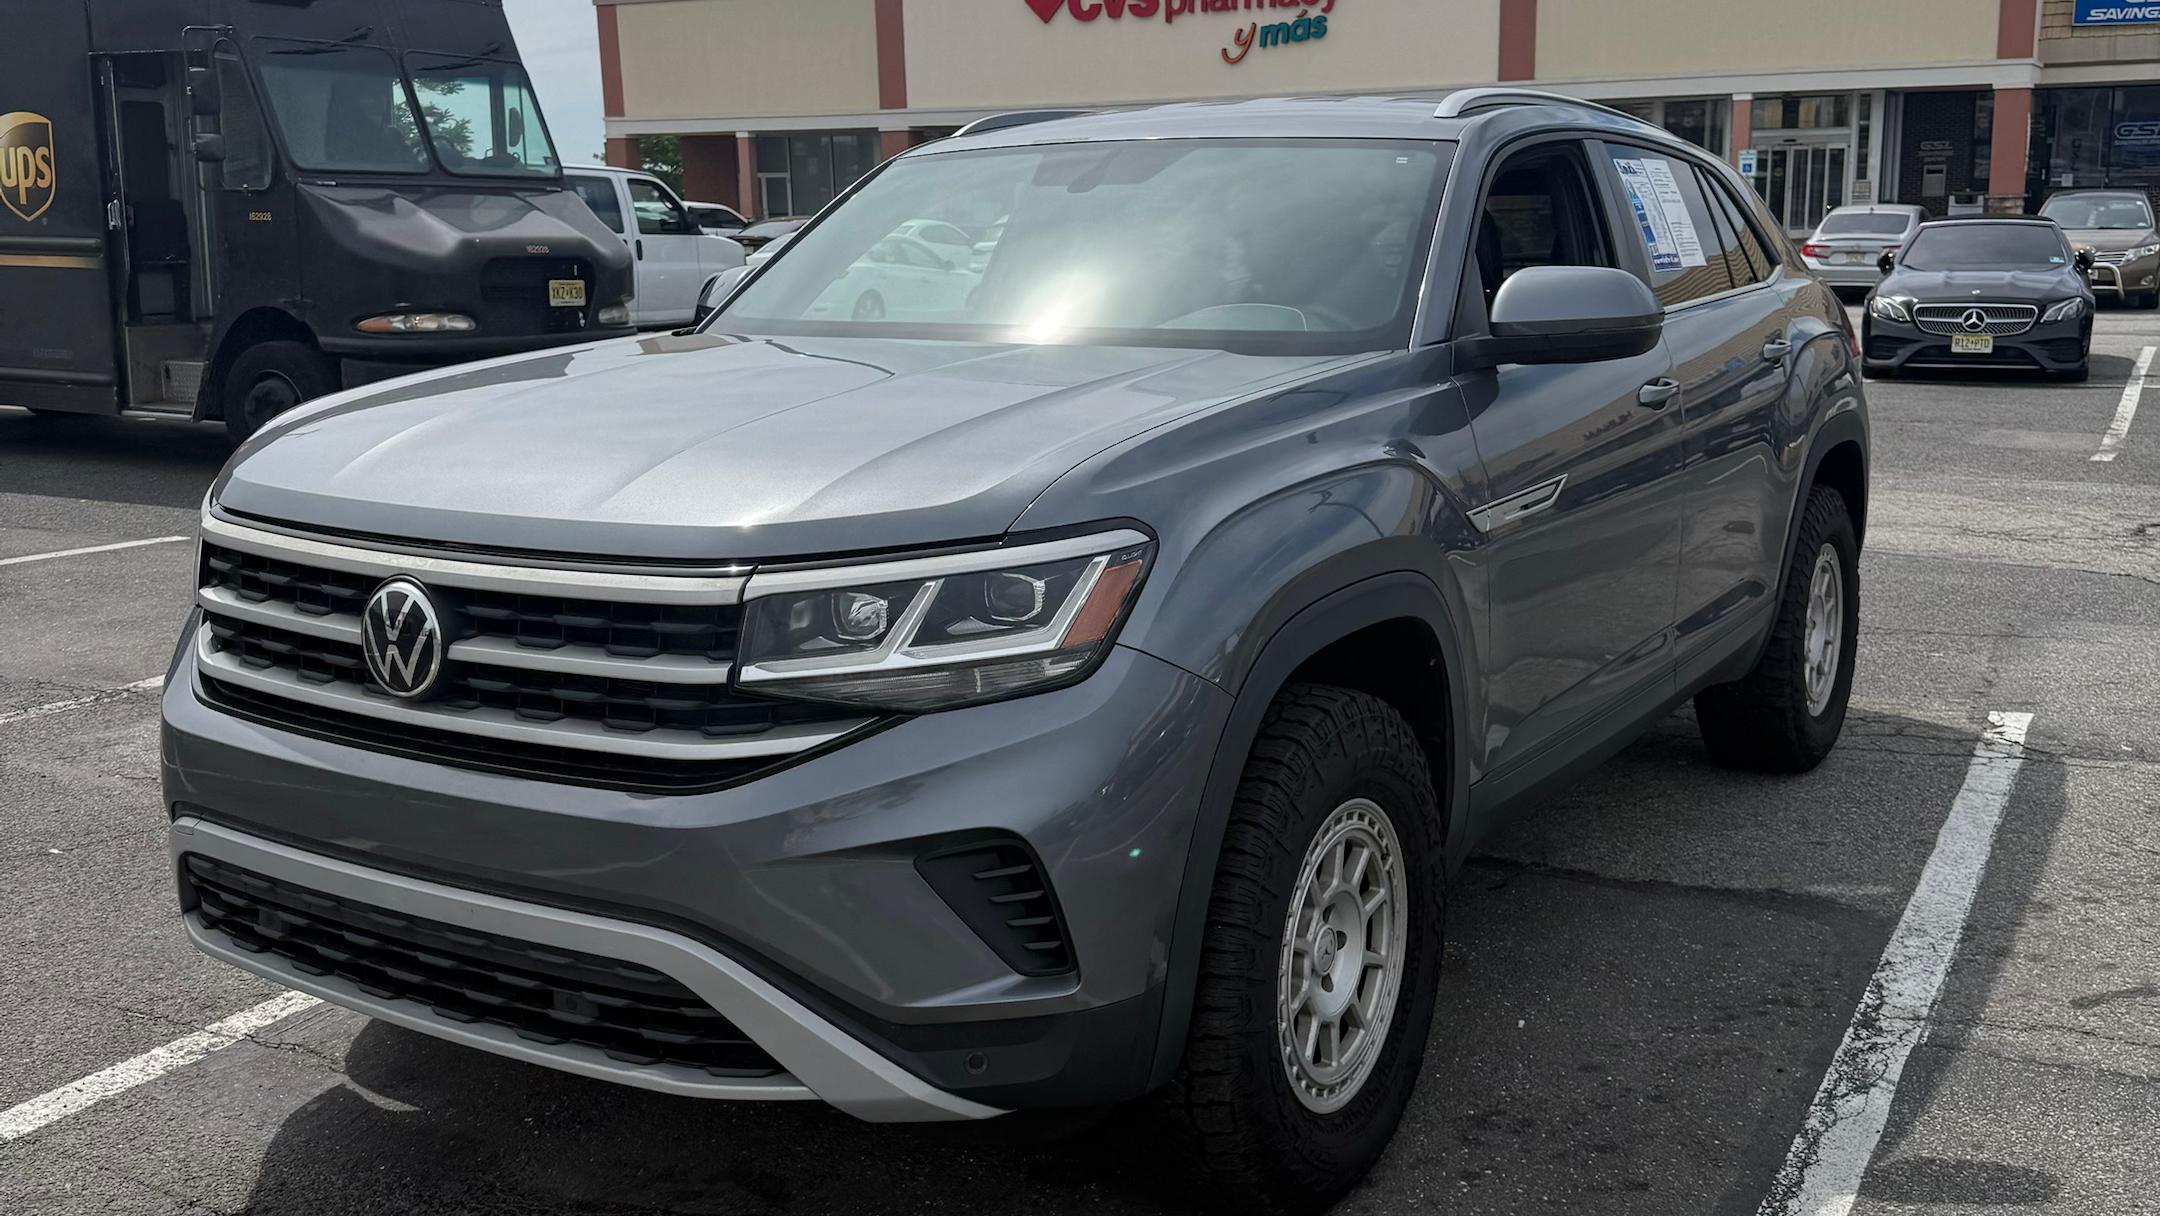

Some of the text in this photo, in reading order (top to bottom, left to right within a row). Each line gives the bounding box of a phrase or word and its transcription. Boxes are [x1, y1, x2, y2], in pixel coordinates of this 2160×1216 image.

[1221, 9, 1328, 64] y más
[2086, 7, 2160, 20] SAVING
[0, 146, 52, 205] ups
